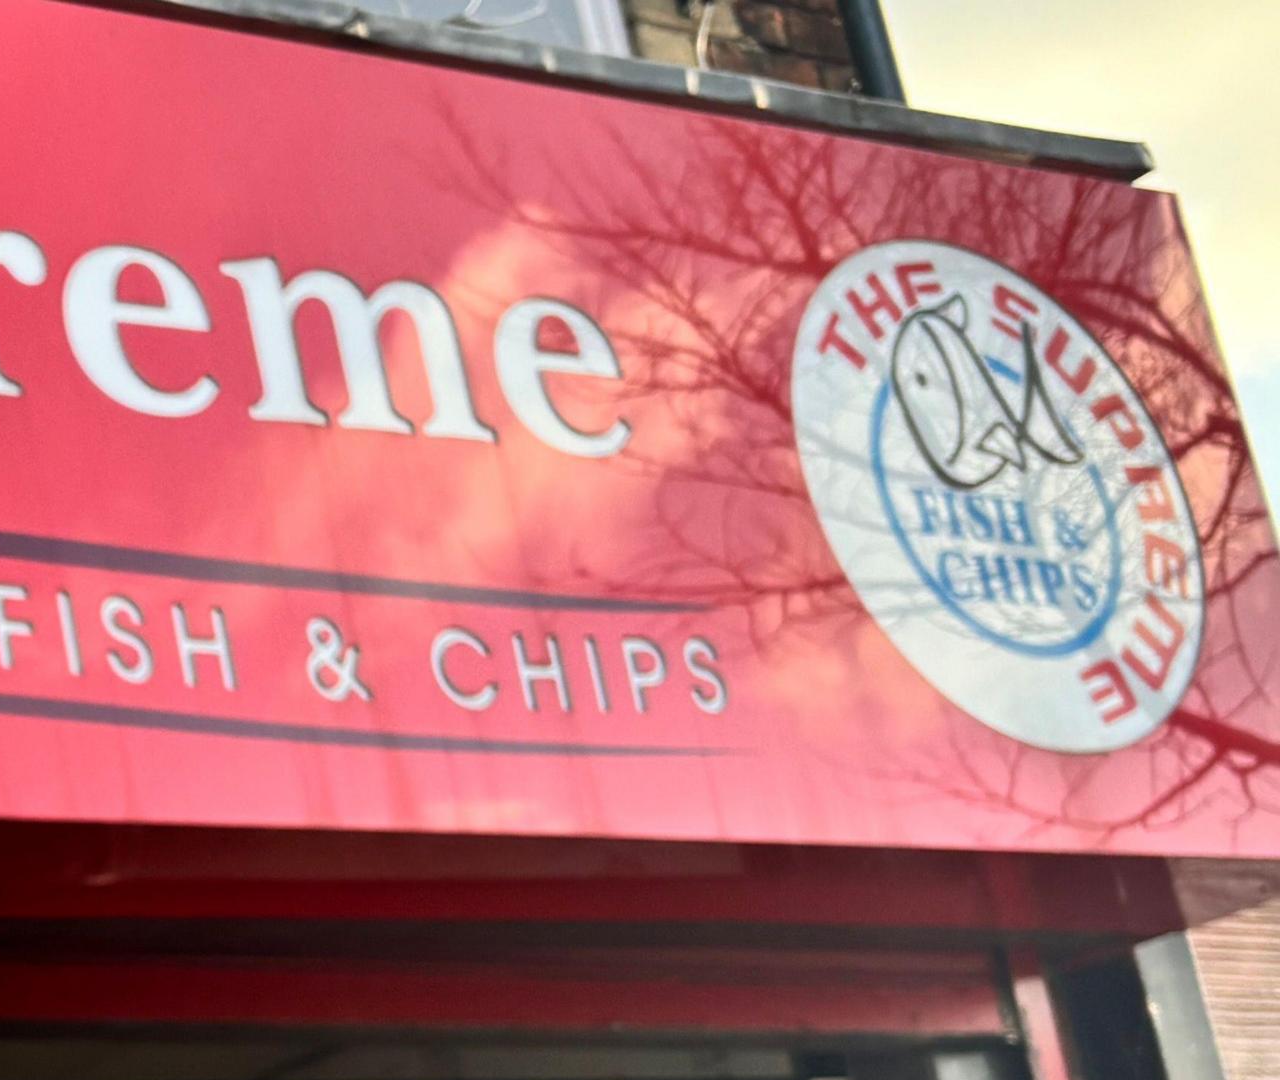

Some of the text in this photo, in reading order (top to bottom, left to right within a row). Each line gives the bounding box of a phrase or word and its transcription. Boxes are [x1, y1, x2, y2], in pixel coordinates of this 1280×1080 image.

[817, 261, 1190, 725] THE SUPREME
[912, 486, 1091, 554] FISH &
[936, 549, 1100, 614] CHIPS
[305, 617, 373, 702] &
[428, 627, 728, 715] CHIPS
